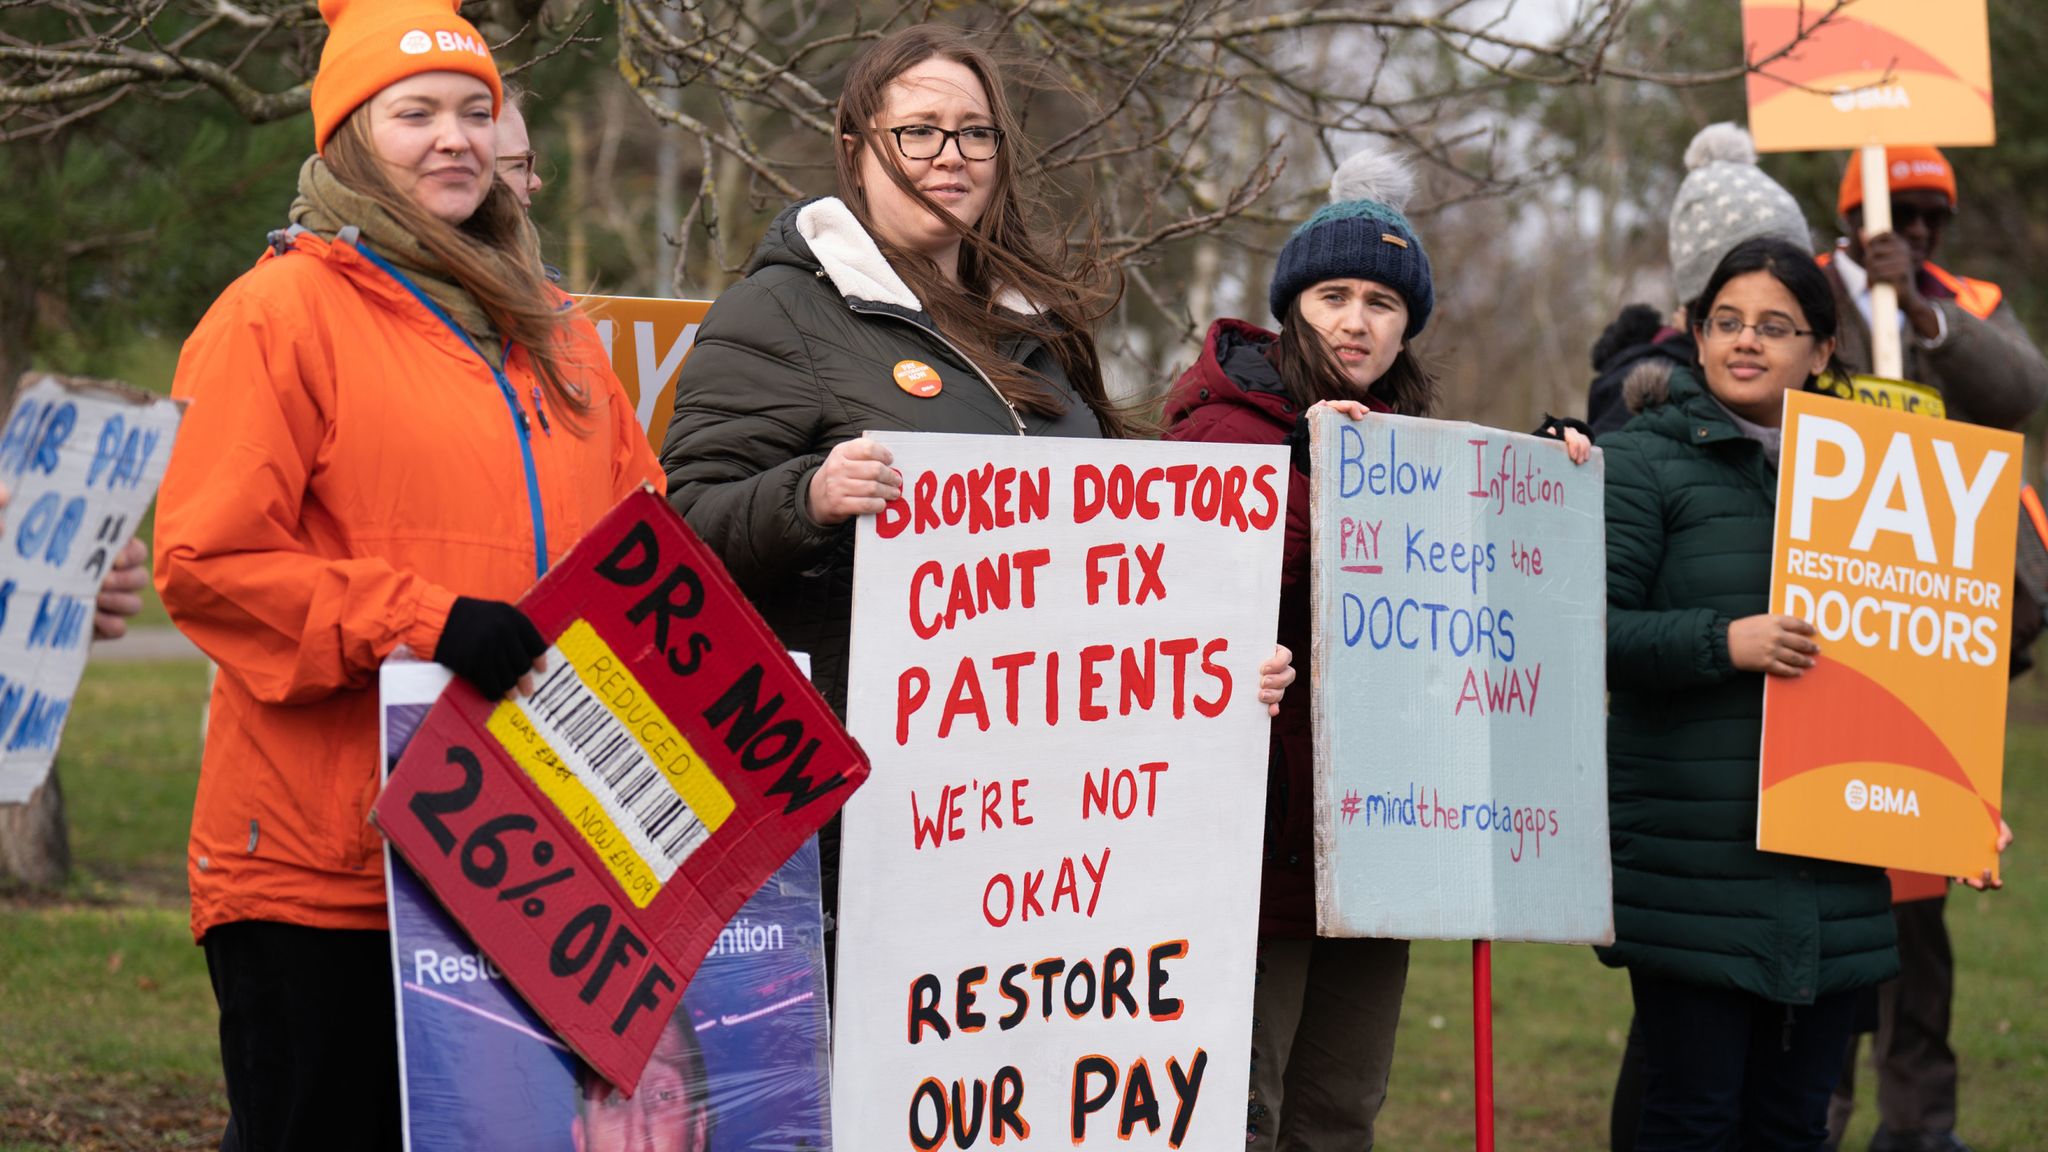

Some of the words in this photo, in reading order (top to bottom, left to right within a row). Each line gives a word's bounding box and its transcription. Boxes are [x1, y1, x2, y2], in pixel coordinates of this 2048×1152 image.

[435, 31, 488, 57] BMA
[86, 412, 160, 490] PAY
[1340, 425, 1442, 498] Below
[1467, 439, 1564, 515] Inflation
[1790, 413, 2010, 570] PAY
[15, 491, 86, 568] OR
[875, 462, 1050, 538] BROKEN
[1073, 463, 1279, 533] DOCTORS
[909, 549, 1051, 640] CANT
[1086, 543, 1167, 606] FIX
[1340, 516, 1383, 561] PAY
[1406, 522, 1497, 595] Keeps
[1511, 540, 1543, 576] the
[1787, 548, 1950, 602] RESTORATION
[1955, 577, 2001, 610] FOR
[1342, 592, 1515, 662] DOCTORS
[1784, 583, 1998, 667] DOCTORS
[509, 712, 536, 744] WAS
[586, 655, 692, 777] REDUCED
[896, 638, 1233, 746] PATIENTS
[1455, 663, 1541, 717] AWAY
[702, 662, 850, 818] NOW
[911, 778, 1034, 850] WE'RE
[1082, 762, 1169, 820] NOT
[1340, 782, 1559, 863] #mindtherotagaps
[1869, 784, 1920, 817] BMA
[407, 746, 575, 918] 26%
[549, 903, 676, 1036] OFF
[575, 805, 615, 850] NOW
[608, 849, 654, 901] £14.09
[983, 847, 1110, 928] OKAY
[908, 939, 1189, 1045] RESTORE
[909, 1064, 1030, 1152] OUR
[1071, 1047, 1208, 1150] PAY
